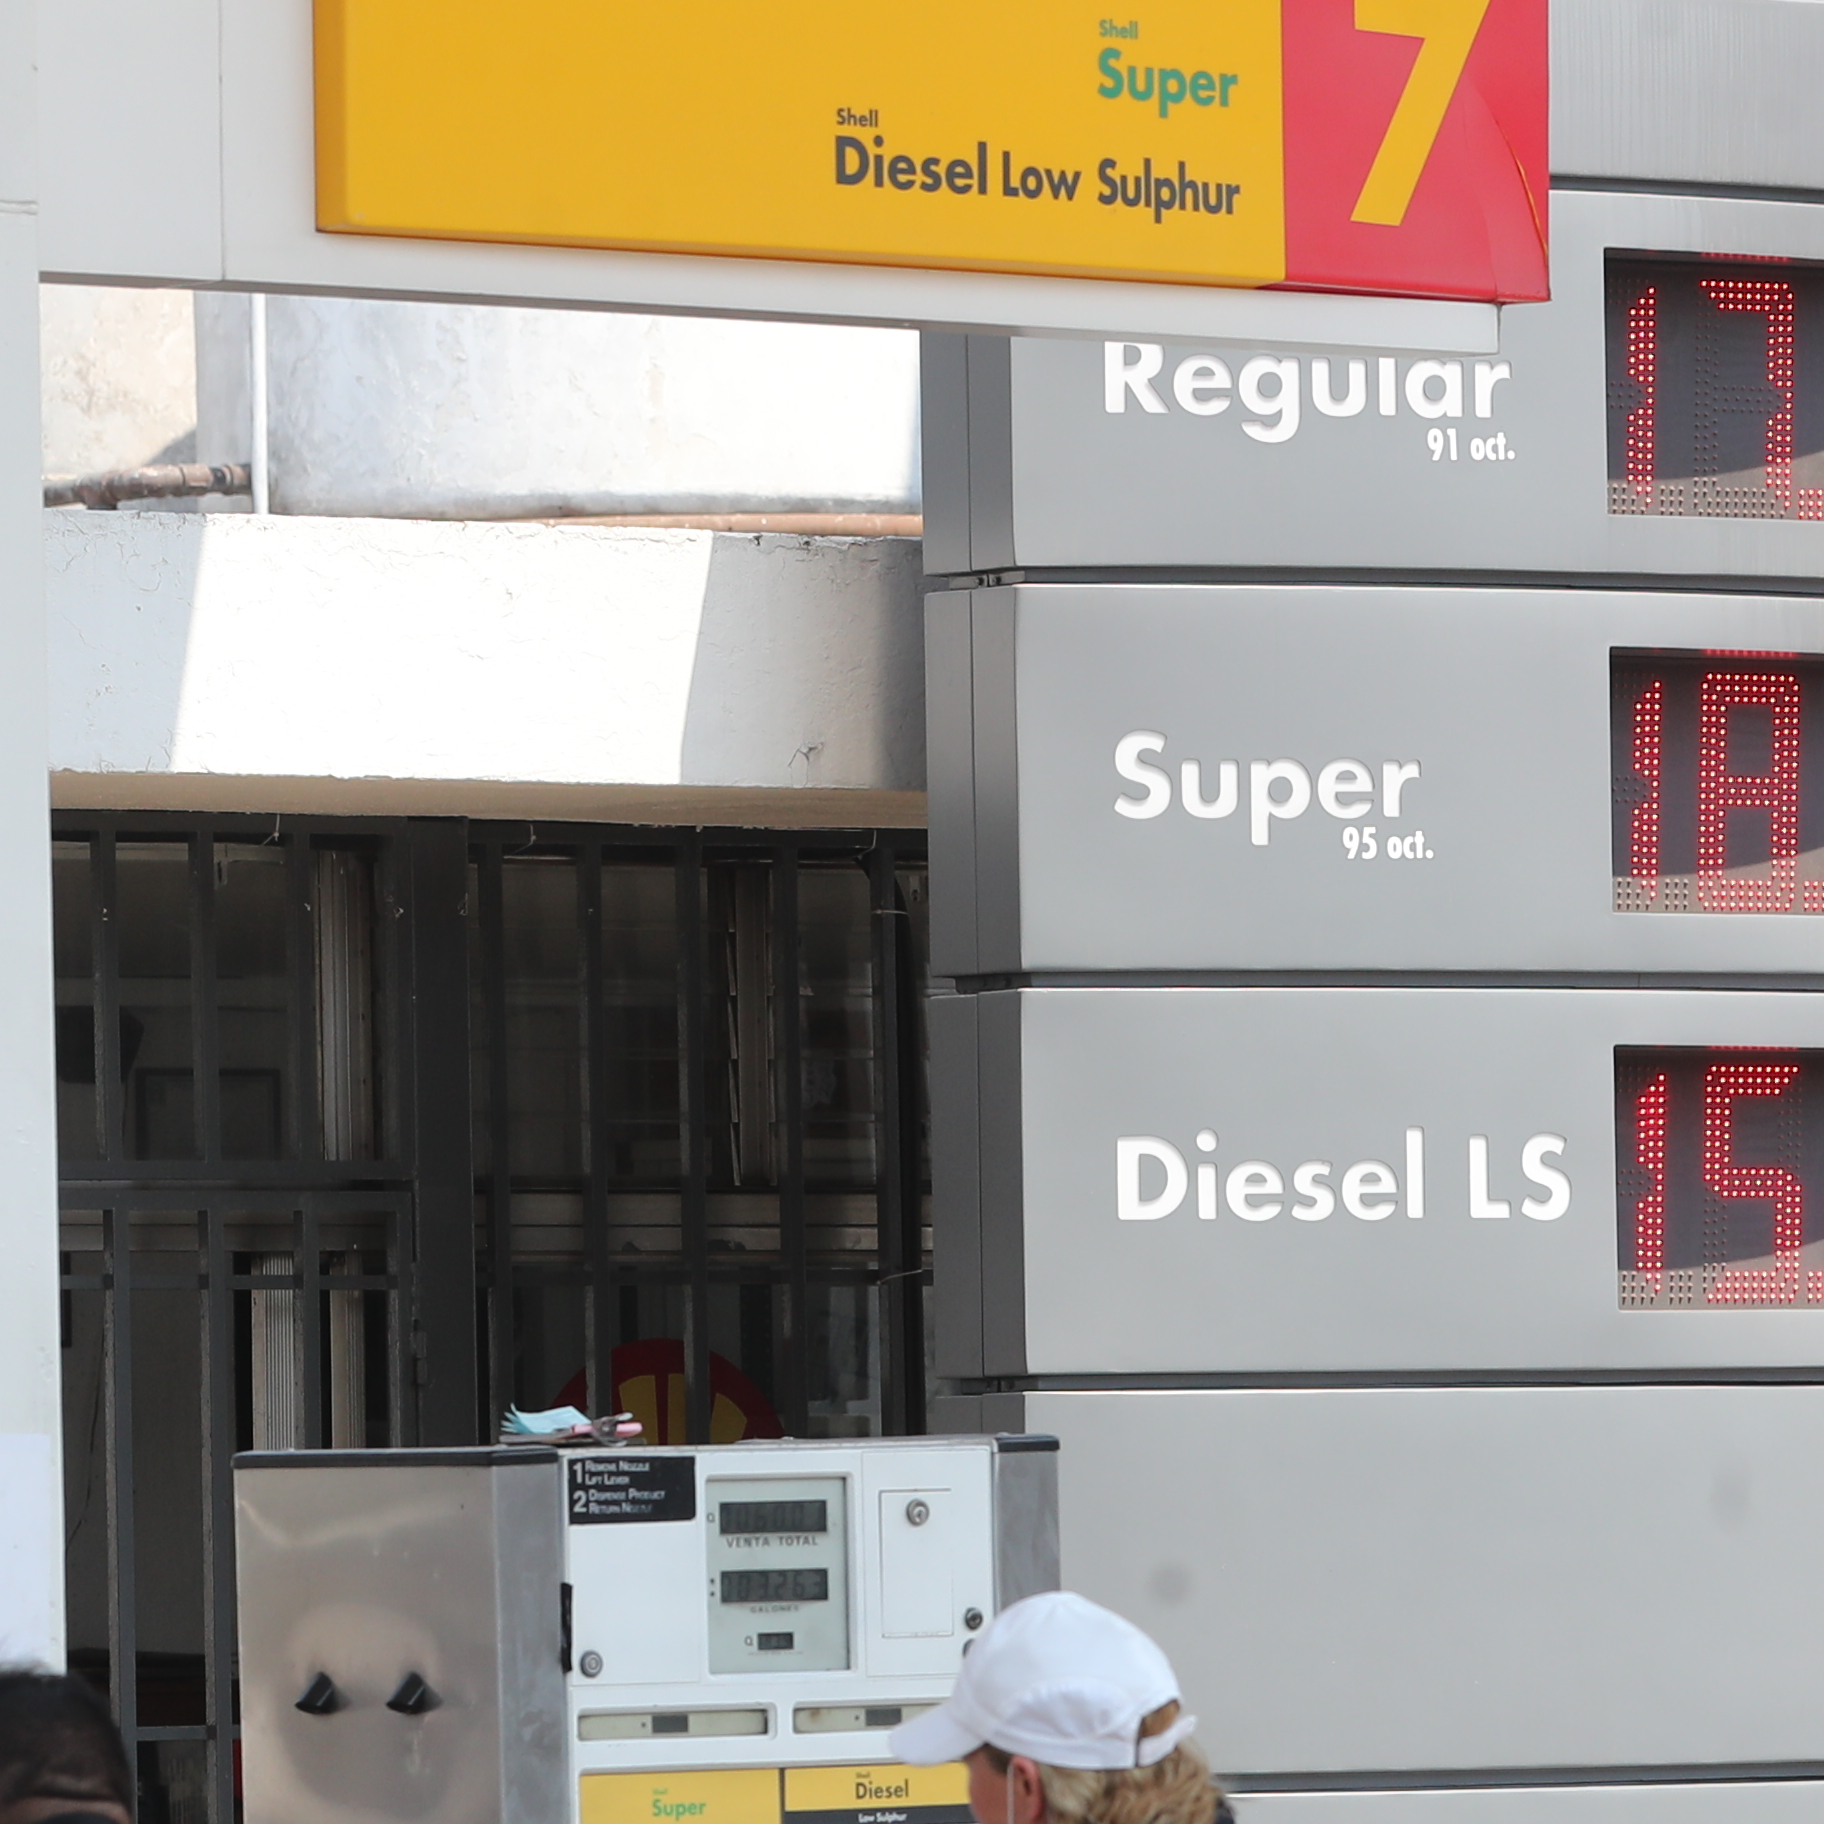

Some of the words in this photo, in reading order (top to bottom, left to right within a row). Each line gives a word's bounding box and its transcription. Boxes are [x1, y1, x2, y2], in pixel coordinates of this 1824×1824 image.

[1098, 19, 1139, 41] Shell
[1097, 46, 1239, 119] Super
[835, 106, 879, 129] Shell
[1350, 0, 1490, 227] 7
[834, 136, 987, 198] Diesel
[1001, 149, 1082, 204] Low
[1096, 156, 1242, 226] Sulphur
[1104, 341, 1513, 443] Regular
[1426, 429, 1463, 461] 91
[1468, 430, 1517, 461] oct.
[1113, 729, 1423, 847] Super
[1342, 826, 1380, 860] 95
[1386, 827, 1435, 860] oct.
[1116, 1125, 1426, 1223] Diesel
[1468, 1133, 1572, 1222] LS
[573, 1461, 583, 1484] 1
[573, 1490, 587, 1513] 2
[725, 1537, 771, 1549] VENTA
[776, 1535, 819, 1547] TOTAL
[854, 1779, 910, 1801] Diesel
[652, 1797, 707, 1822] Super
